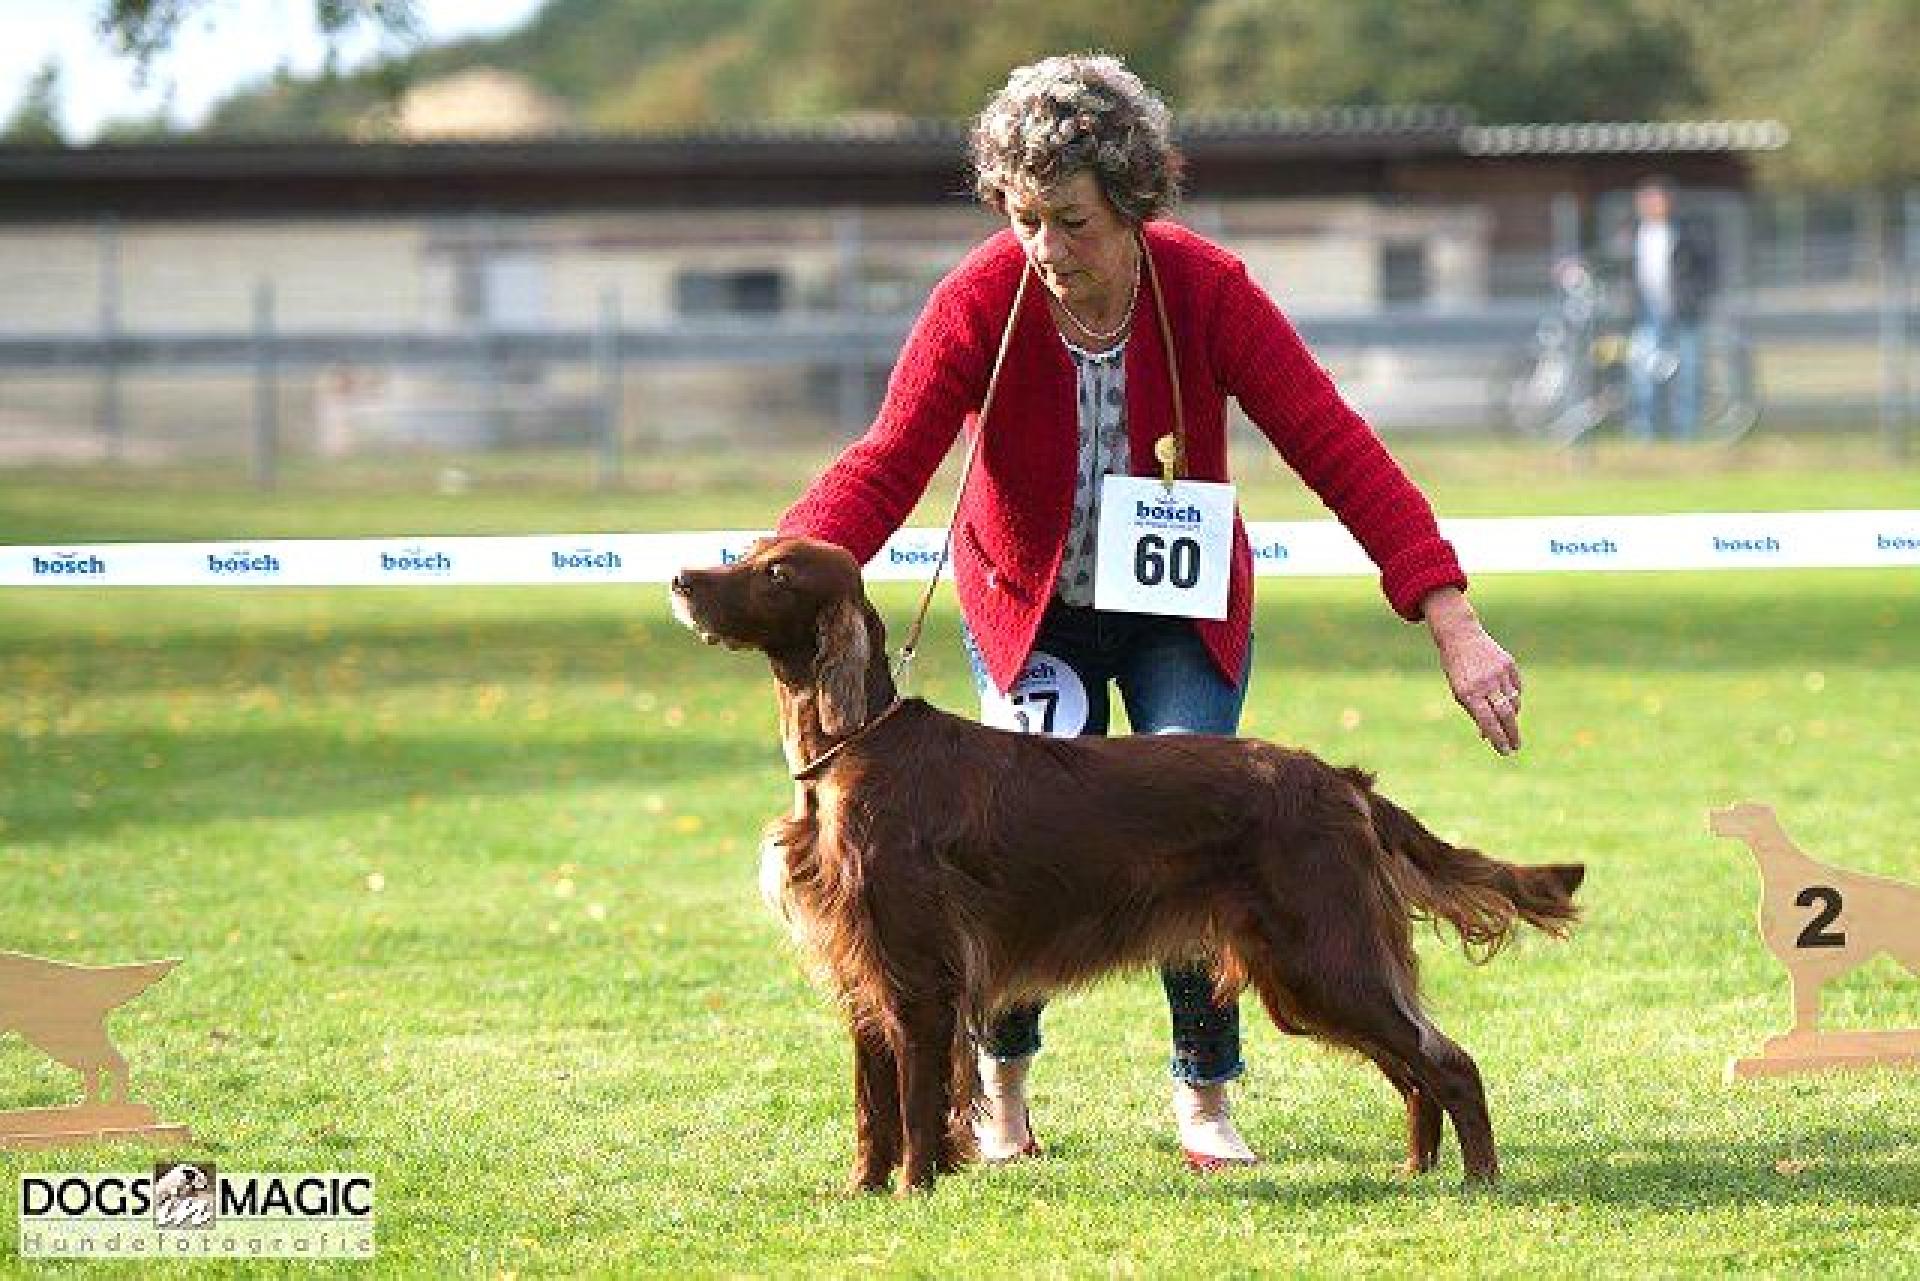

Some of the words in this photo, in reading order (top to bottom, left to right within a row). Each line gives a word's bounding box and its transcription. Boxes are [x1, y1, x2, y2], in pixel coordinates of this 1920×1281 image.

[1137, 501, 1201, 522] bosch
[1551, 540, 1617, 556] bosch
[1713, 536, 1780, 552] bosch
[33, 554, 105, 573] bosch
[207, 554, 279, 571] bosch
[380, 552, 450, 570] bosch
[552, 551, 621, 568] bosch
[1134, 533, 1200, 588] 60
[1794, 885, 1845, 948] 2
